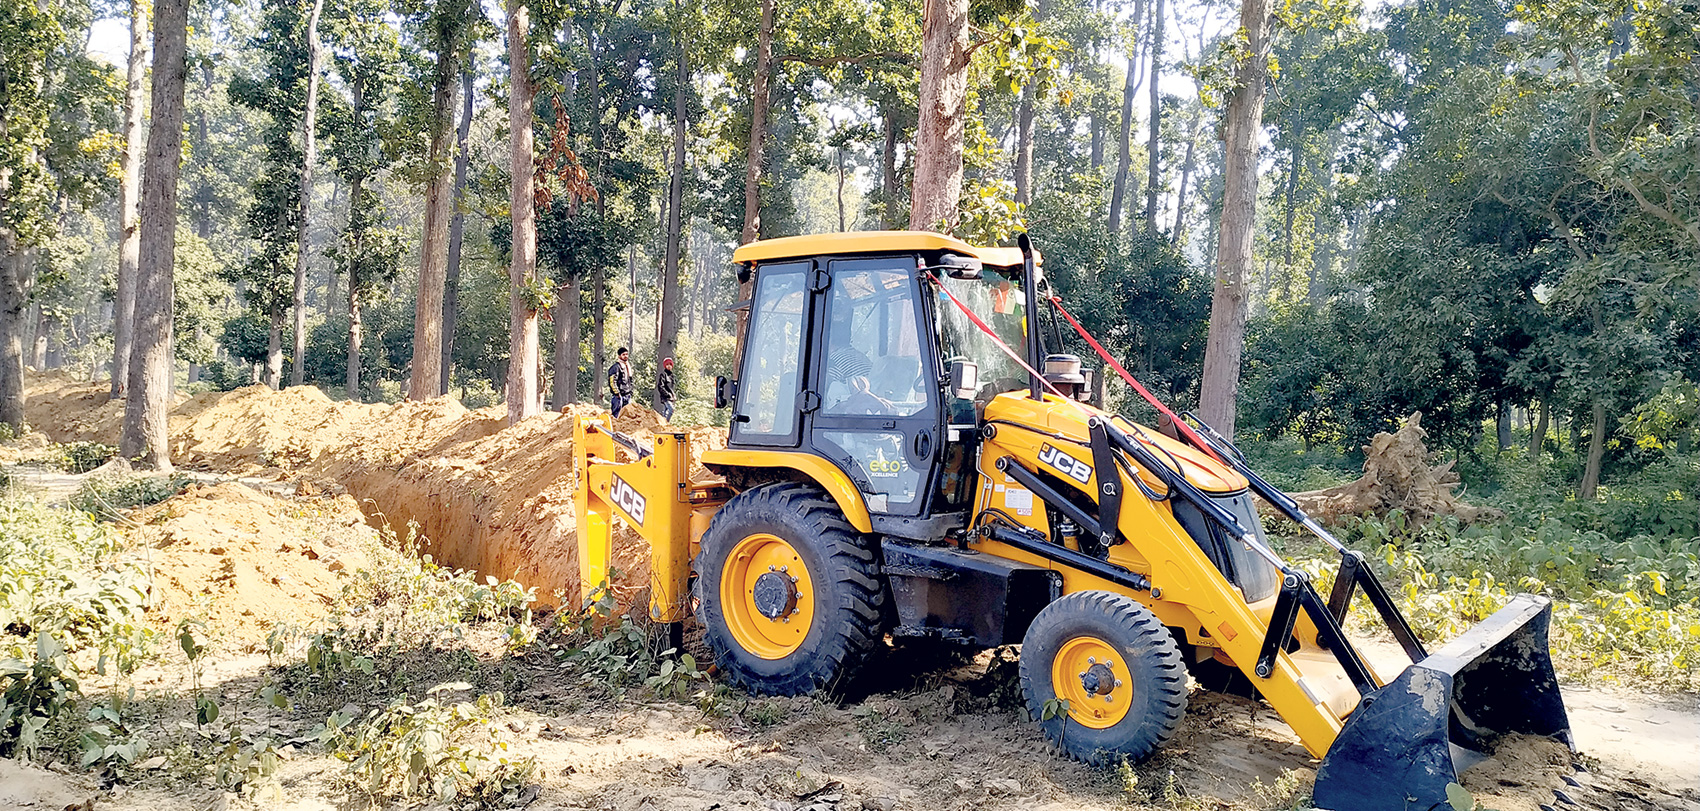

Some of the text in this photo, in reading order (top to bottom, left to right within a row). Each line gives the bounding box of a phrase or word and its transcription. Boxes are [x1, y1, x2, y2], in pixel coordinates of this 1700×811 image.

[869, 460, 901, 473] eco
[1038, 447, 1091, 483] JCB
[610, 477, 646, 524] JCB
